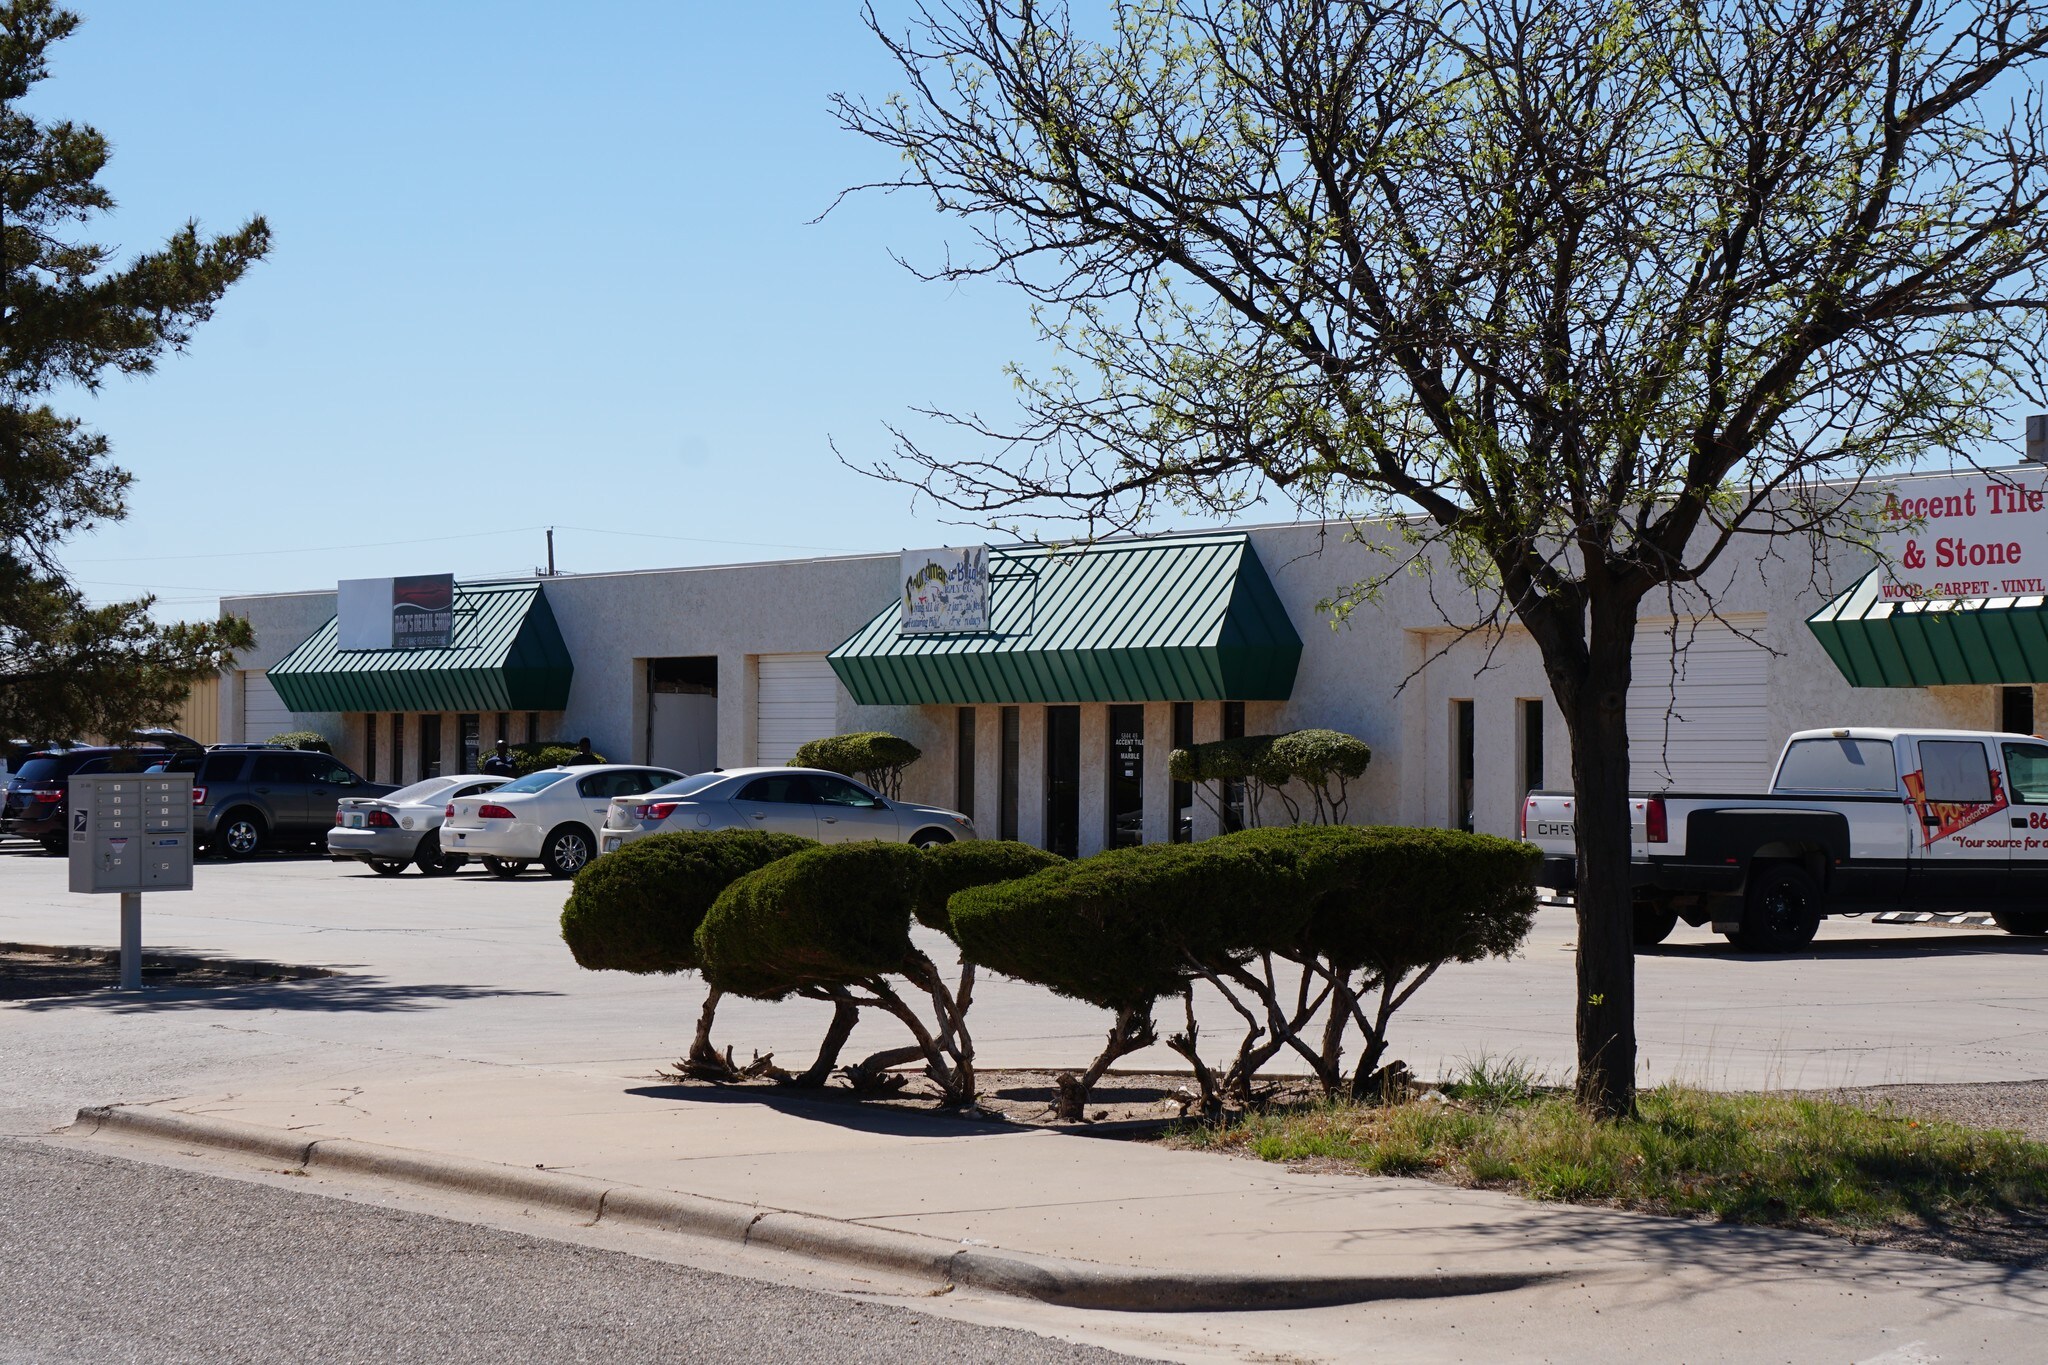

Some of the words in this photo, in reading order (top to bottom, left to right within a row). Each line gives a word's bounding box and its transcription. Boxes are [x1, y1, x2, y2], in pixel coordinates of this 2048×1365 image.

[1884, 487, 1976, 521] Accent
[1987, 483, 2044, 514] Tile
[1903, 539, 1926, 570] &
[1935, 537, 2021, 568] Stone
[1934, 580, 1990, 596] CARPET
[2001, 578, 2045, 593] VINYL
[414, 613, 433, 632] DETAIL
[435, 612, 451, 631] SHOP
[1986, 839, 2022, 848] source
[2024, 836, 2041, 851] for
